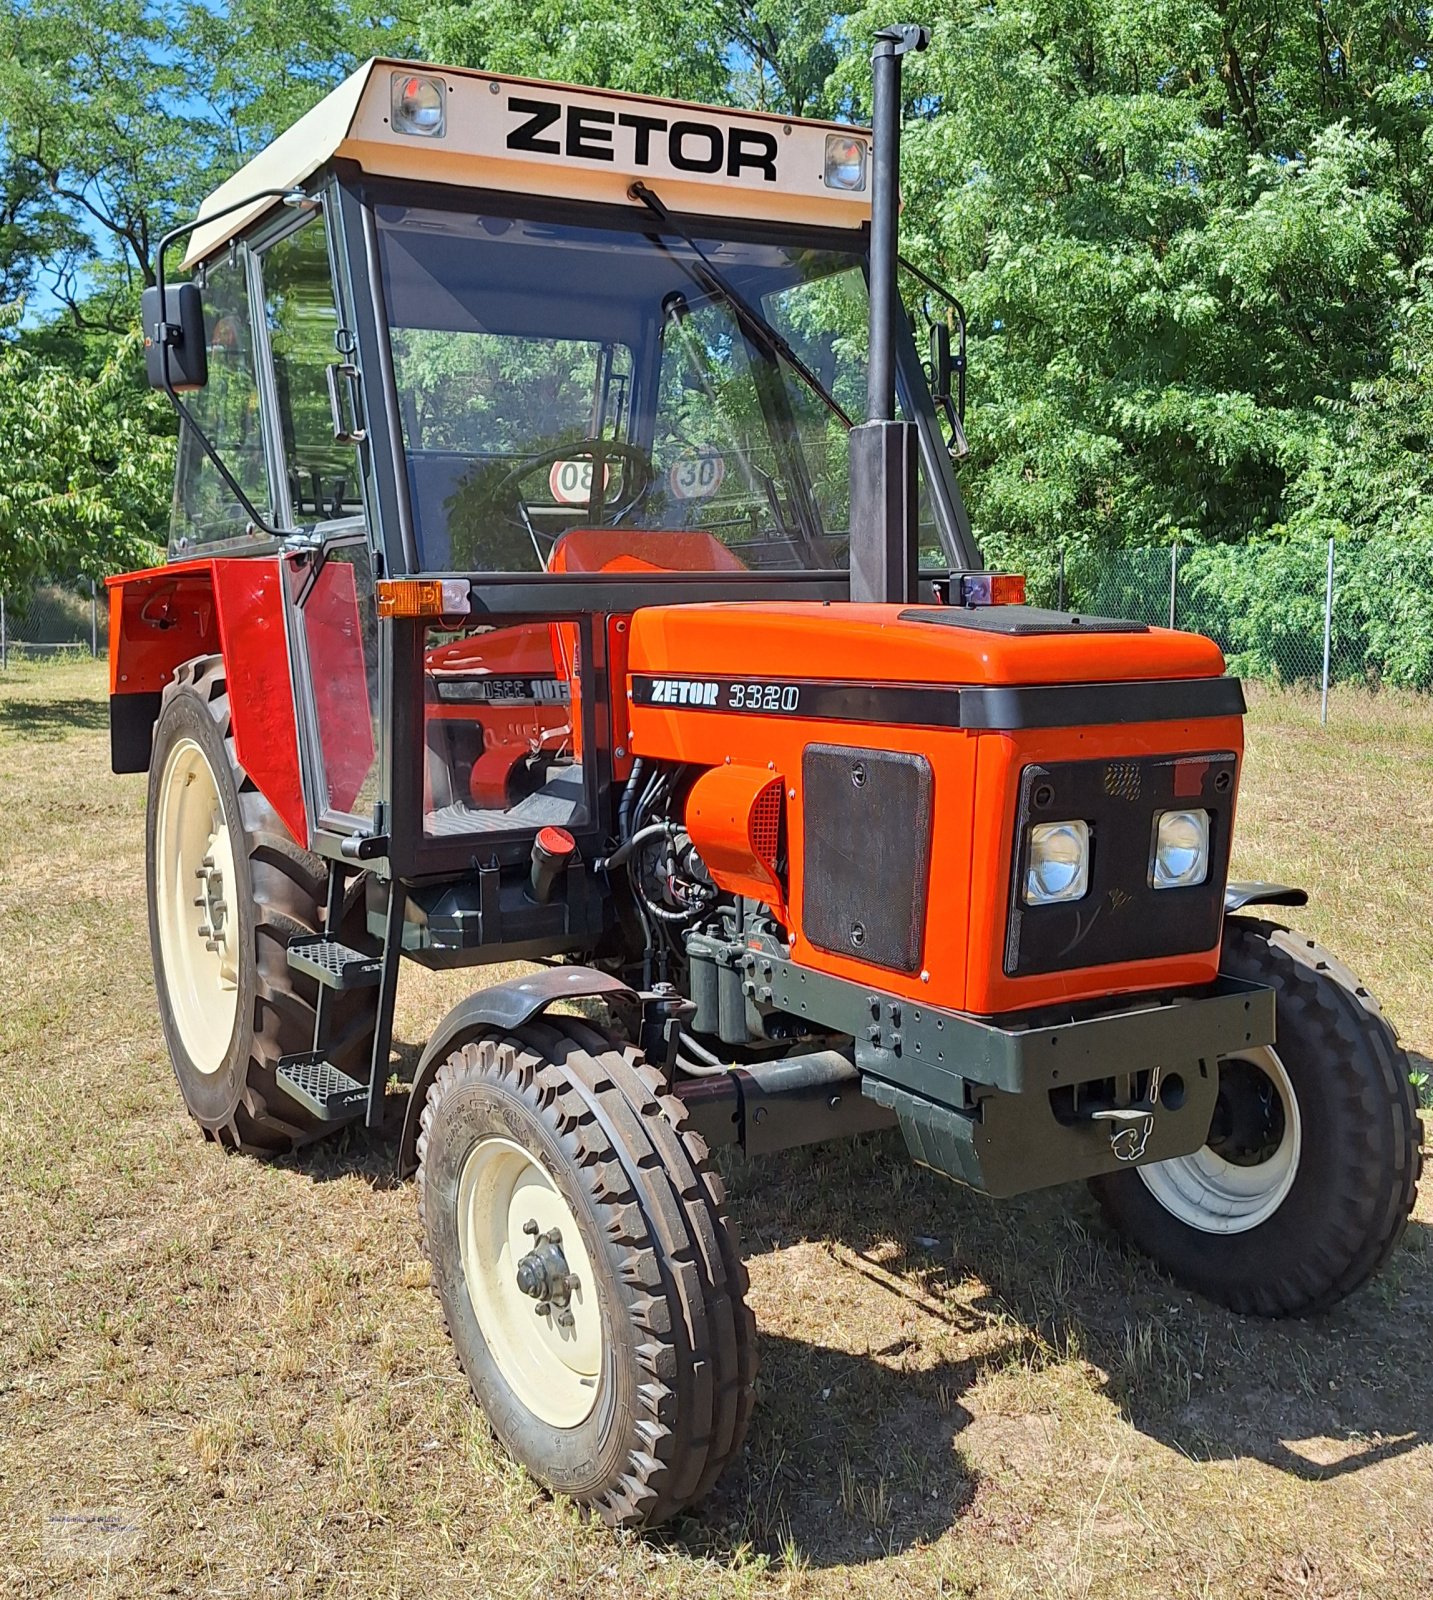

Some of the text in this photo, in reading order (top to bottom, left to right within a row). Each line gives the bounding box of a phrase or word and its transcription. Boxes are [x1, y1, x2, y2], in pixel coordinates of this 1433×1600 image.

[507, 97, 778, 181] ZETOR
[651, 680, 799, 711] ZETOR 3320
